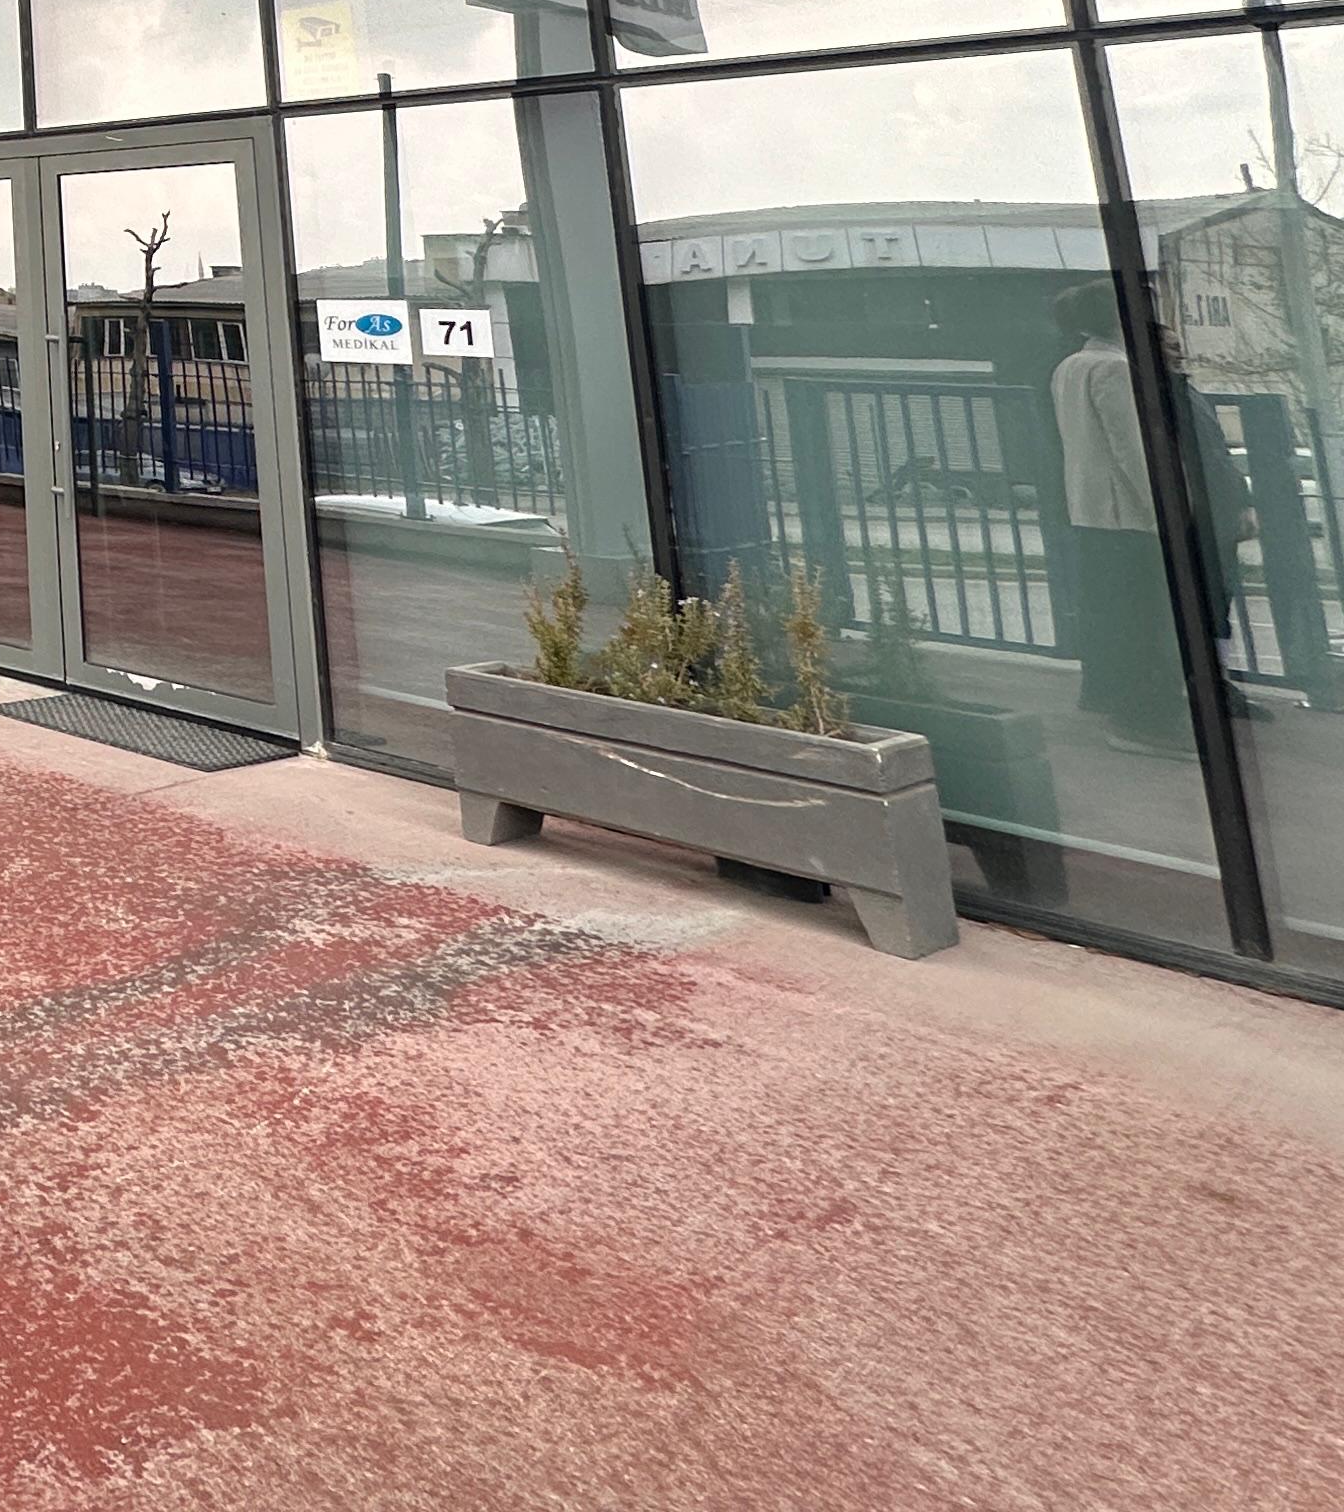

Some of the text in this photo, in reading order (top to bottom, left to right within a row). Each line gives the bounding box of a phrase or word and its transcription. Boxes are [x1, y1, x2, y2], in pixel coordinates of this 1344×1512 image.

[324, 314, 392, 333] For As
[438, 320, 474, 346] 71
[332, 338, 400, 351] MEDİKAL
